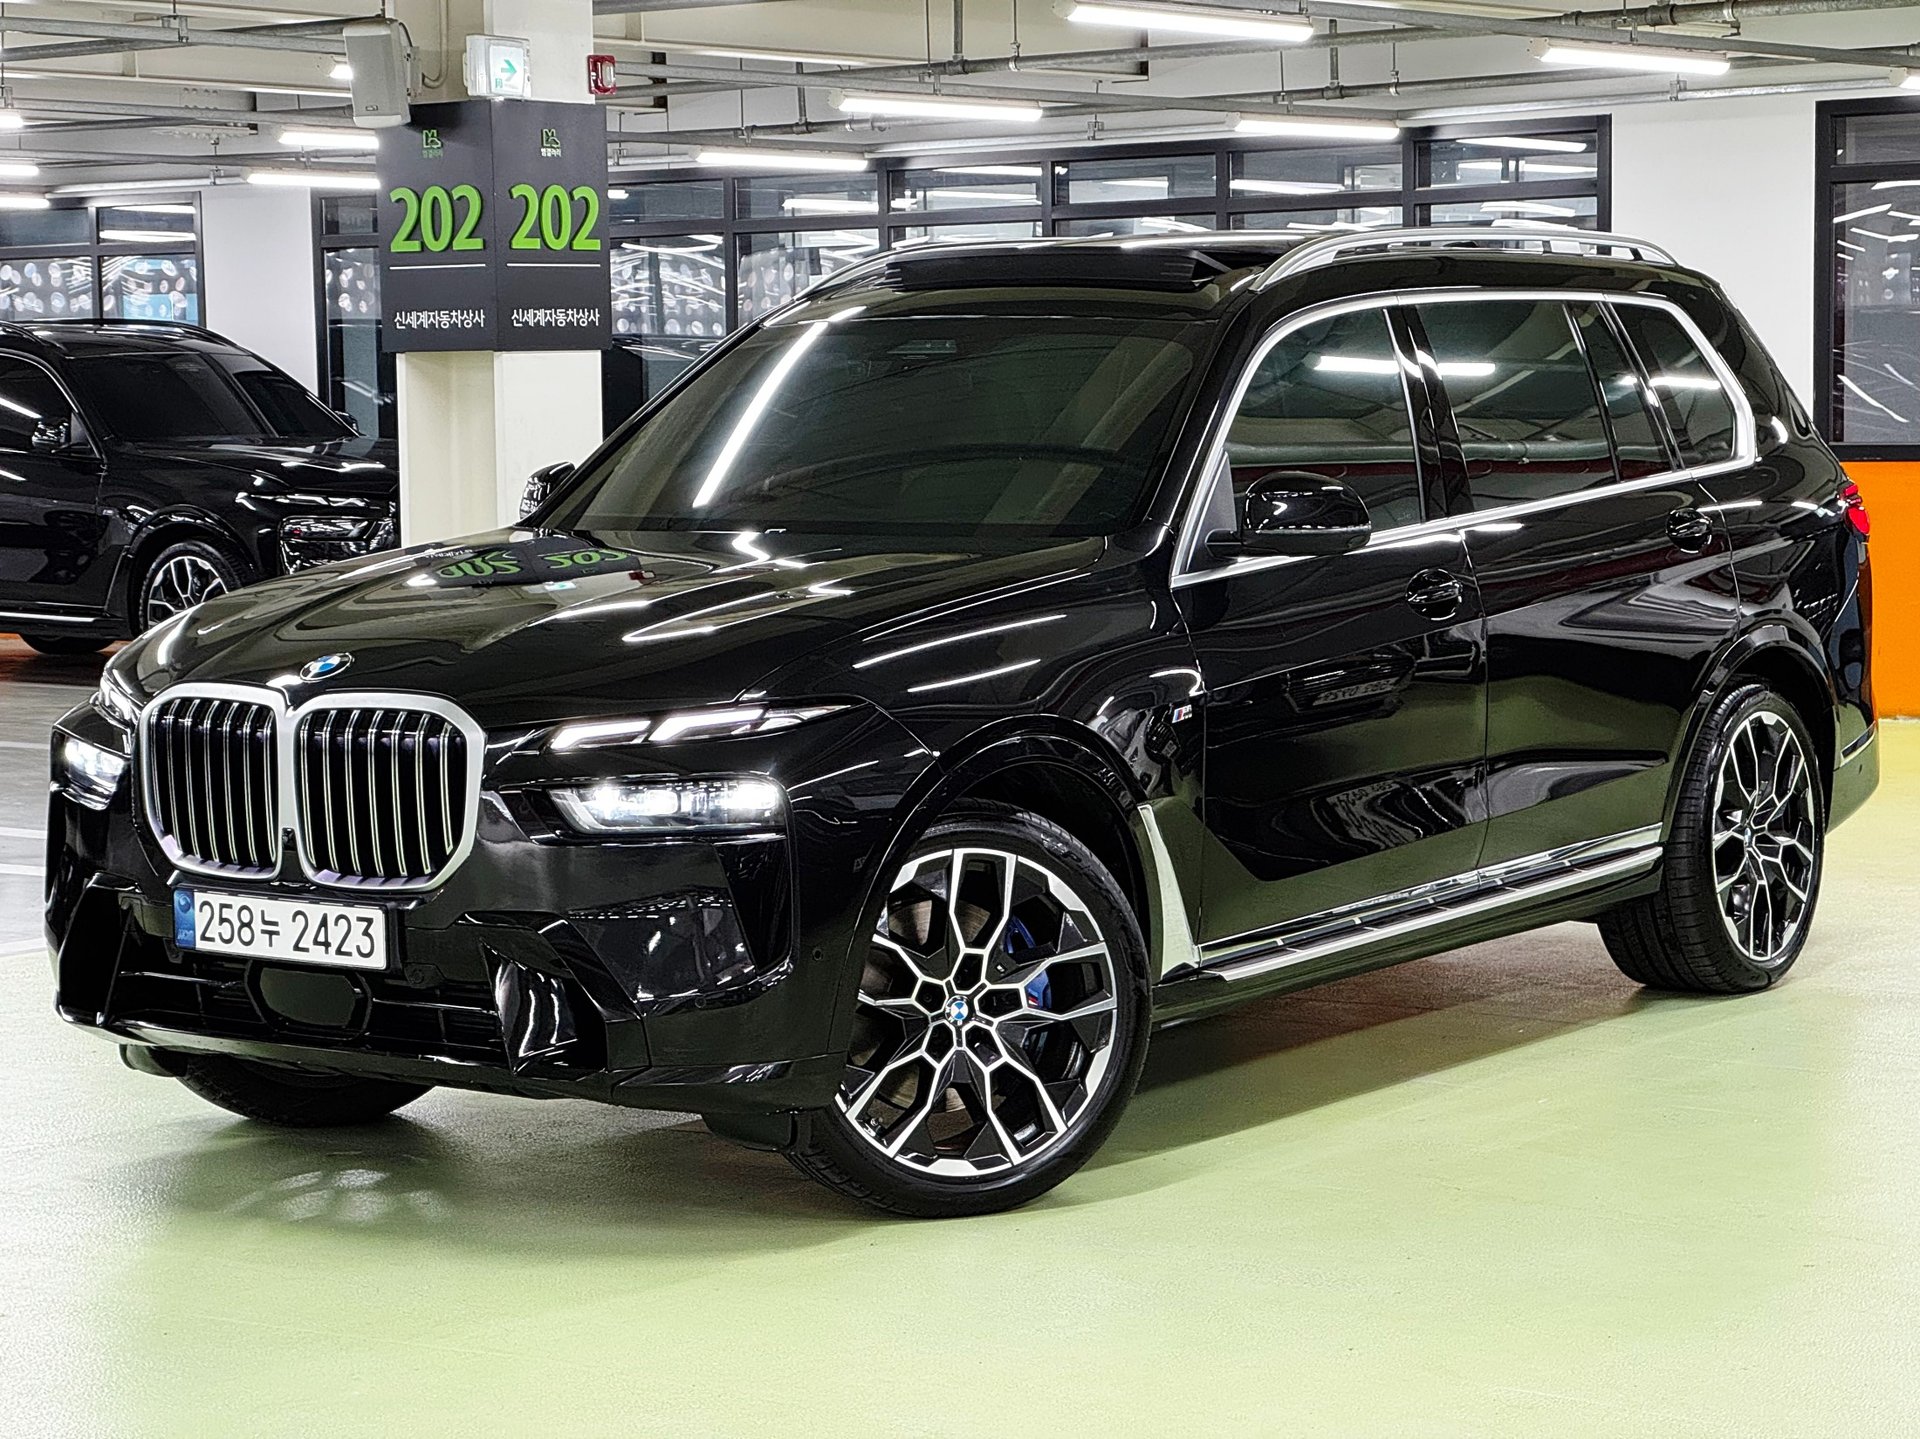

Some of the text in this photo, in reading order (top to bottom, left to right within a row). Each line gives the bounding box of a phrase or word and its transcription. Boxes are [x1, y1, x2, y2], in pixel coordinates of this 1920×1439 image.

[390, 185, 484, 252] 202
[510, 183, 600, 250] 202
[394, 309, 486, 329] 신세계자동차상사
[511, 308, 601, 327] 신세계자동차상사
[199, 901, 375, 958] 258누 2423
